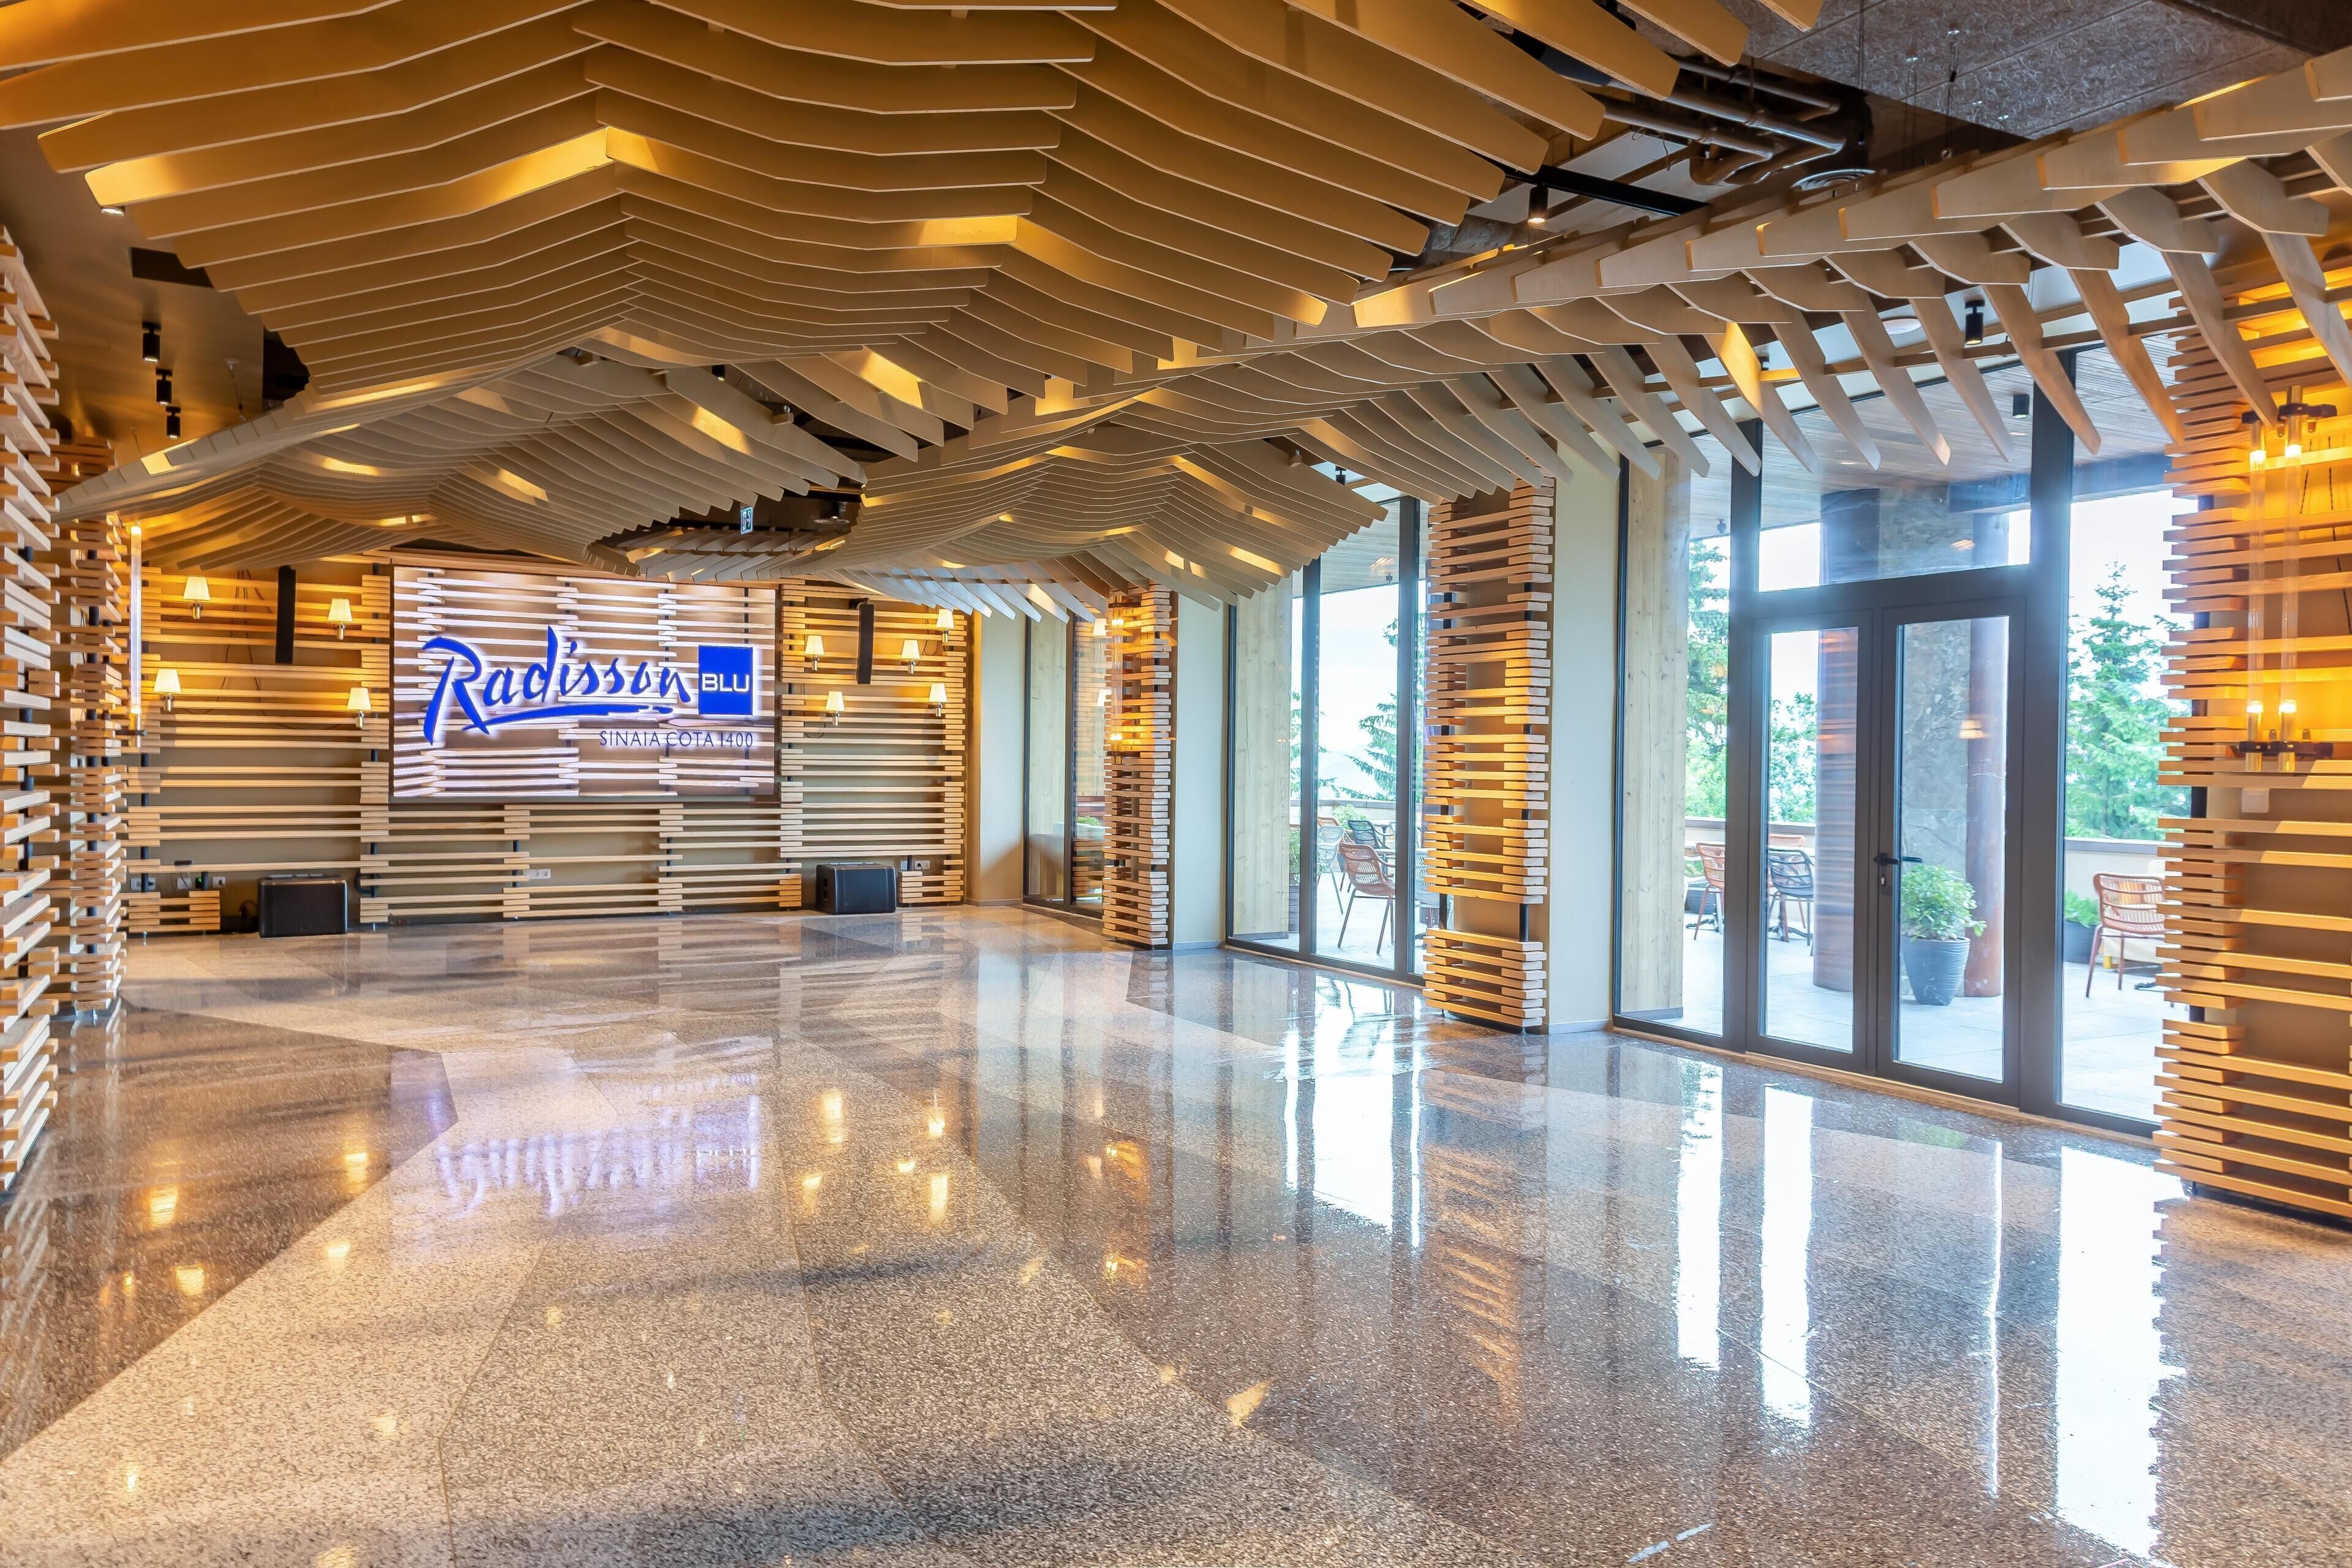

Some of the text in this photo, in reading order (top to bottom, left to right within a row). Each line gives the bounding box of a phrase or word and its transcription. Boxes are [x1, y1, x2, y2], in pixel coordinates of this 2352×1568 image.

[422, 625, 750, 745] Radisson BLU
[600, 731, 753, 747] SINAIA COTA 1400
